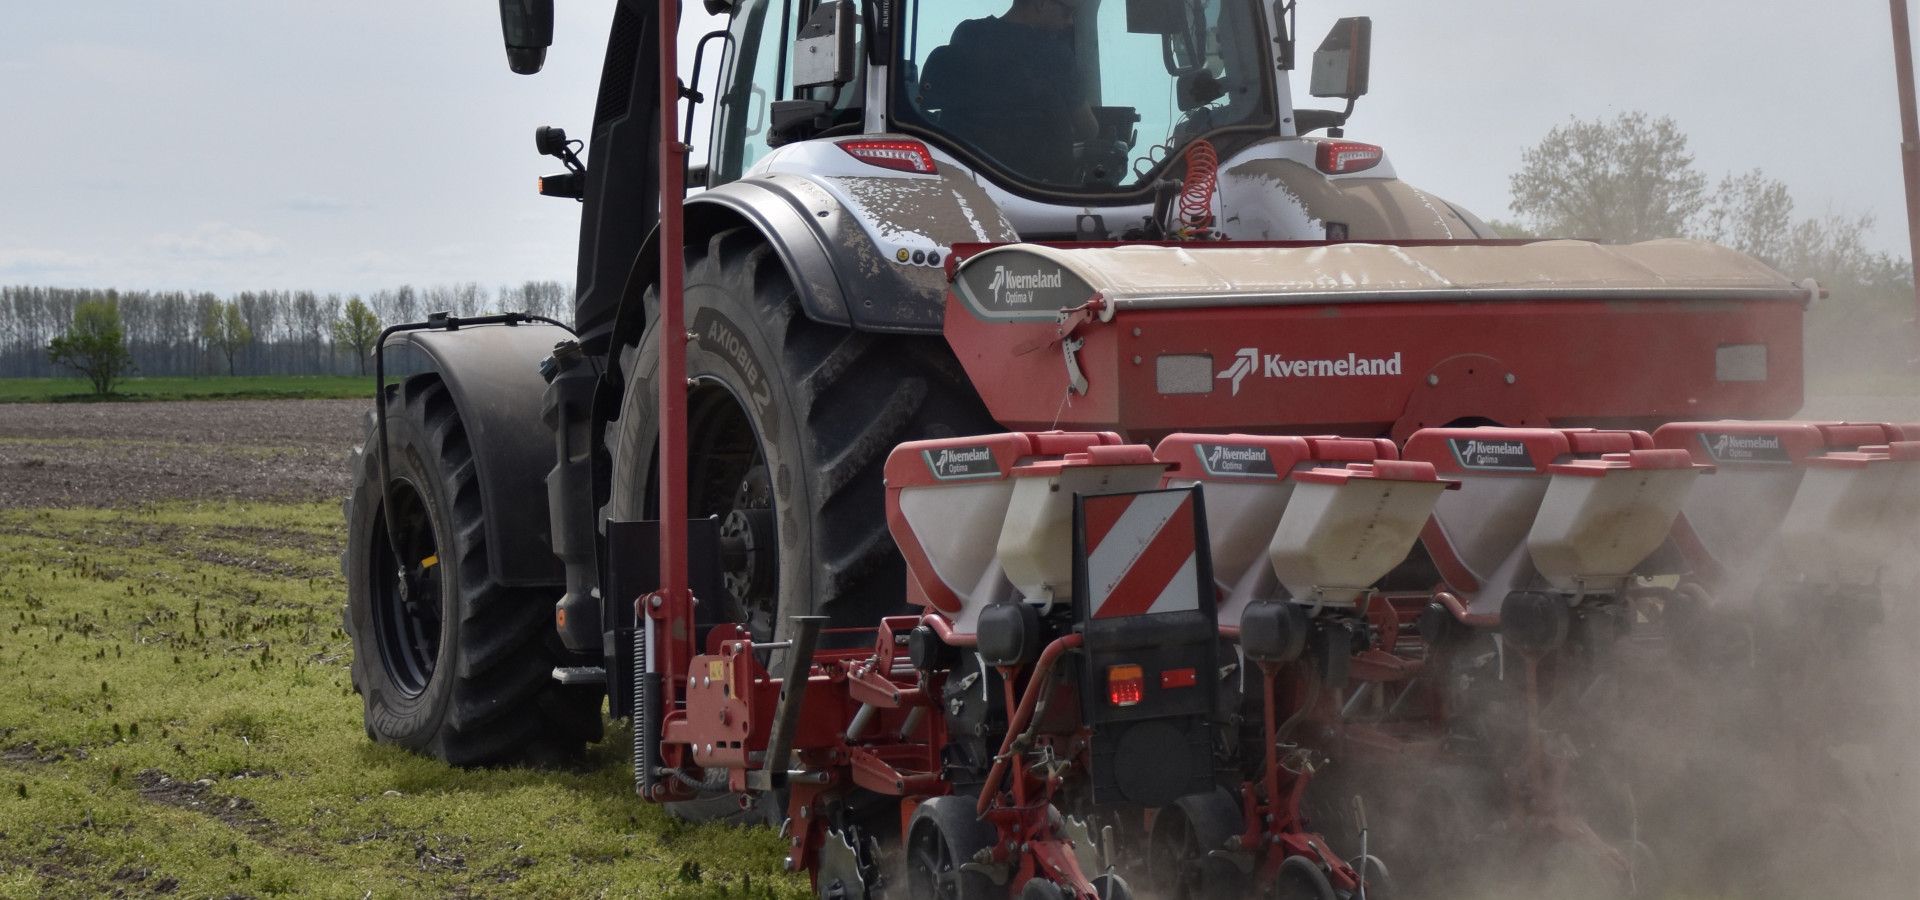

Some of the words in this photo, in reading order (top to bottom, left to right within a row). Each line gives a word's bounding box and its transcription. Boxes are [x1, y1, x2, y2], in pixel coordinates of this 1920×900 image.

[1005, 268, 1062, 289] Kverneland
[1005, 291, 1027, 306] Optima
[1028, 291, 1034, 303] V
[707, 320, 758, 386] AXIOBIB
[752, 379, 771, 415] 2
[1263, 352, 1402, 378] Kverneland
[1476, 442, 1524, 455] Kverneland
[1729, 435, 1778, 449] Kverneland
[948, 447, 990, 463] Kverneland
[1222, 447, 1267, 461] Kverneland
[1476, 454, 1499, 465] Optima
[948, 464, 968, 474] Optima
[1221, 461, 1243, 471] Optima
